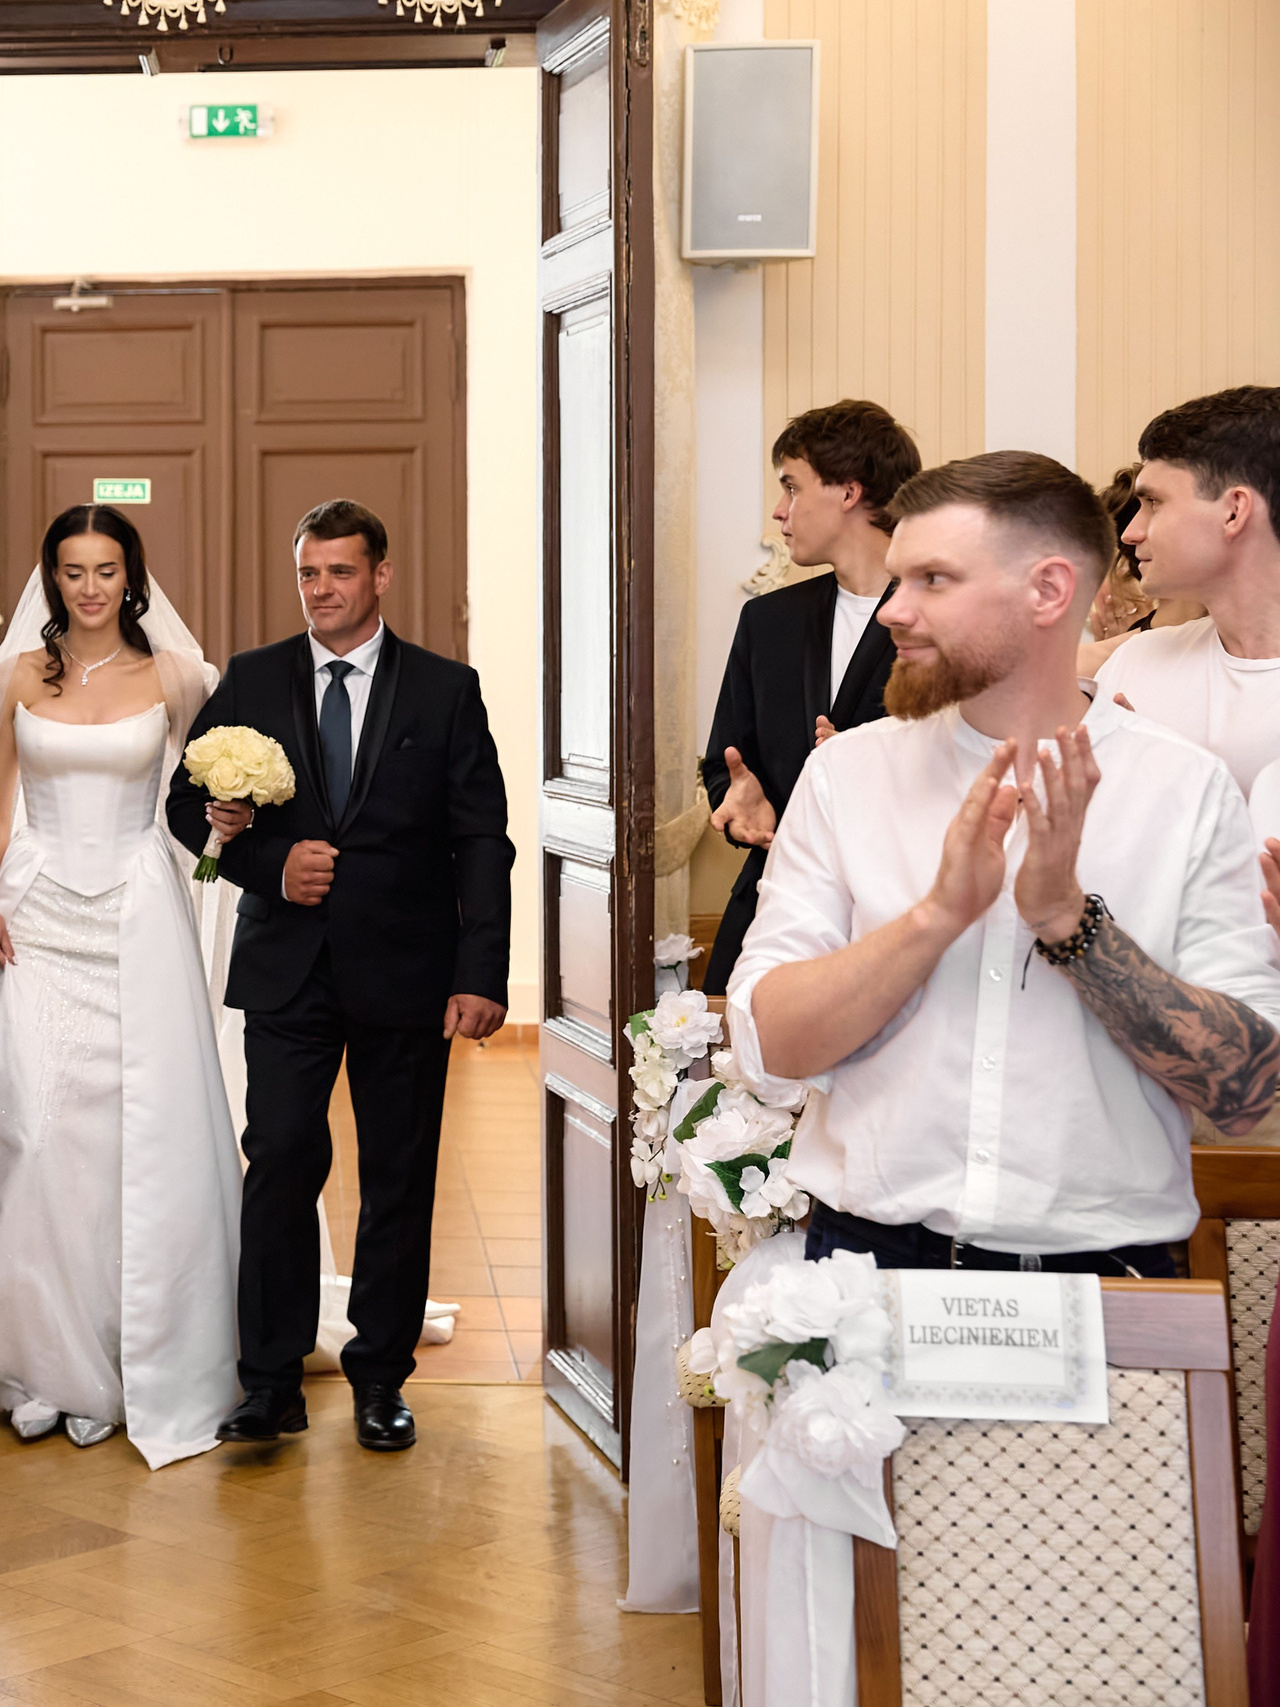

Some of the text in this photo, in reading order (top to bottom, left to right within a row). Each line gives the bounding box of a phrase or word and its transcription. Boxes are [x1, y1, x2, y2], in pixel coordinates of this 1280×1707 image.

[99, 484, 144, 498] IZEJA
[941, 1297, 1020, 1318] VIETAS
[908, 1325, 1060, 1348] LIECINIEKIEM
